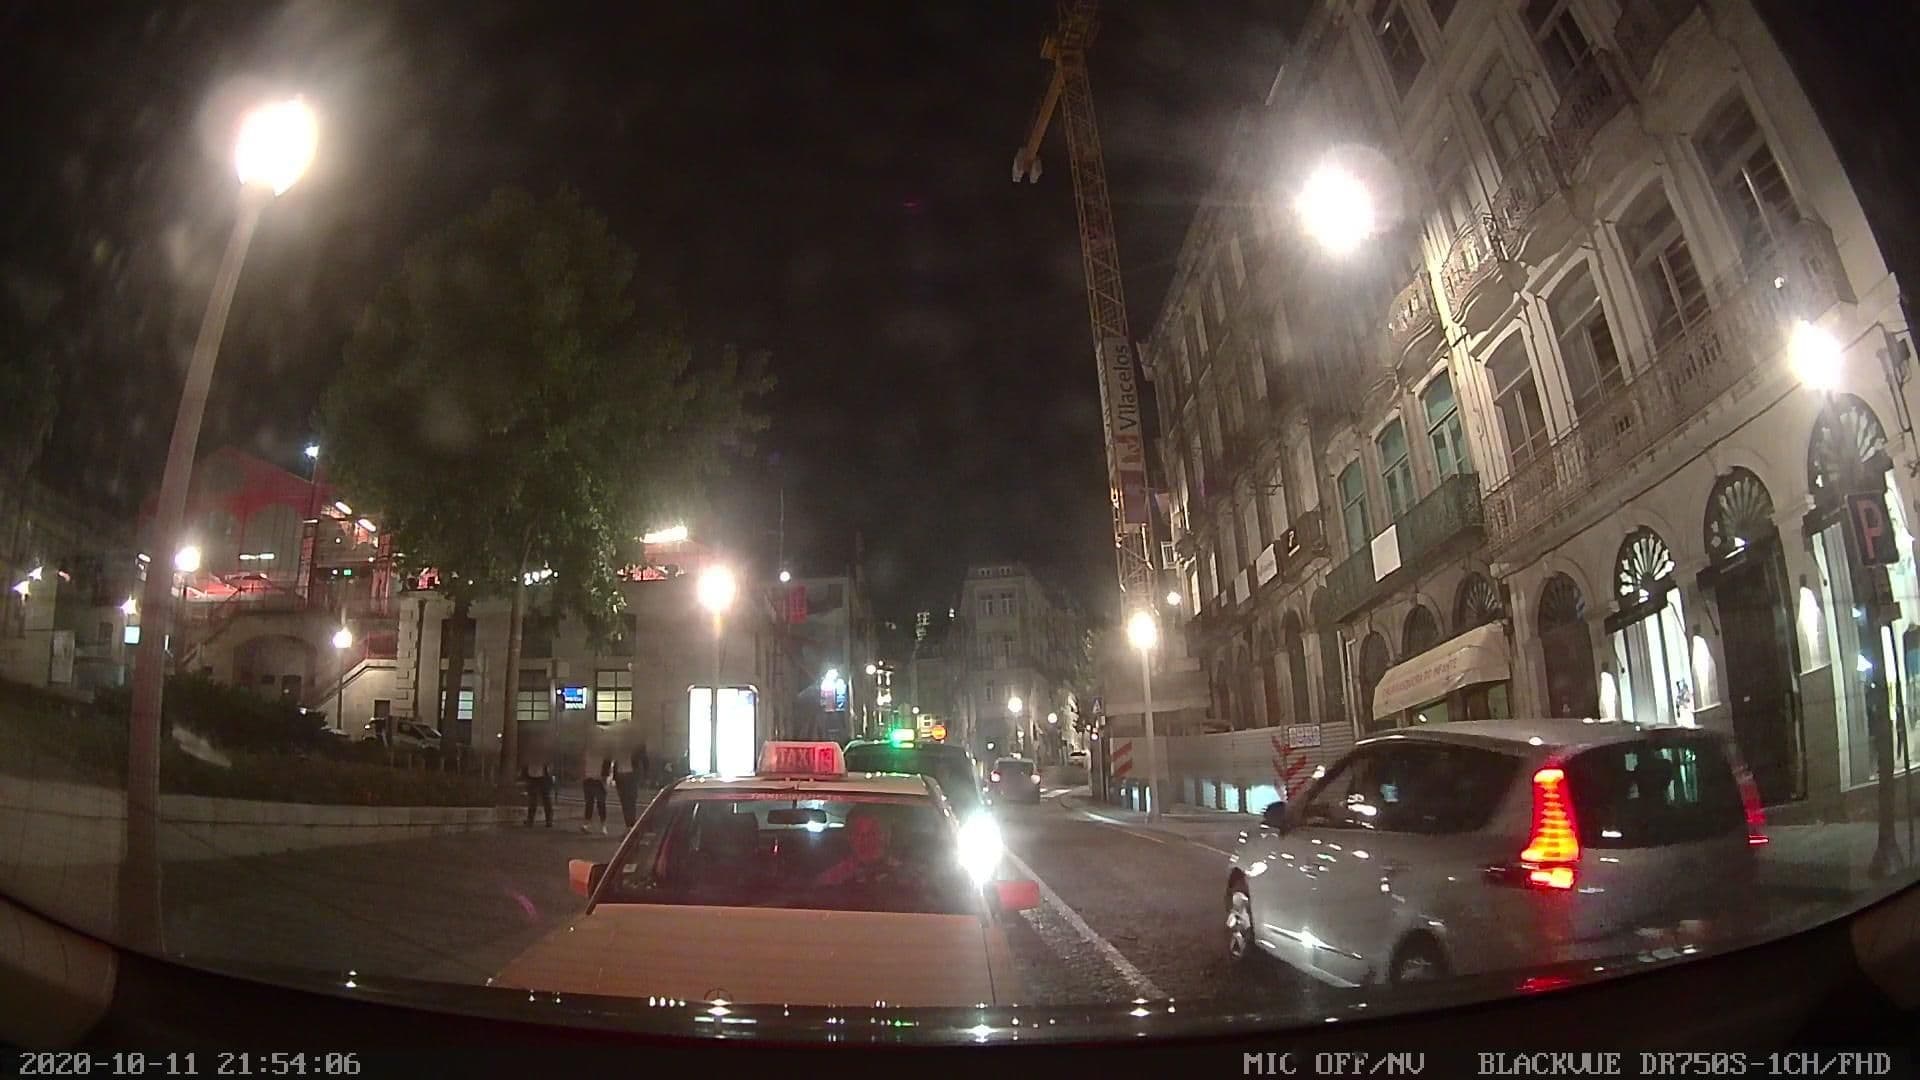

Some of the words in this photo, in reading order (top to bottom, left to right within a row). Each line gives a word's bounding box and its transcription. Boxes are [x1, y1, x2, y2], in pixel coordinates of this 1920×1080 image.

[1112, 343, 1138, 431] Vilacelos
[1856, 500, 1884, 560] P
[777, 747, 816, 772] TAXI
